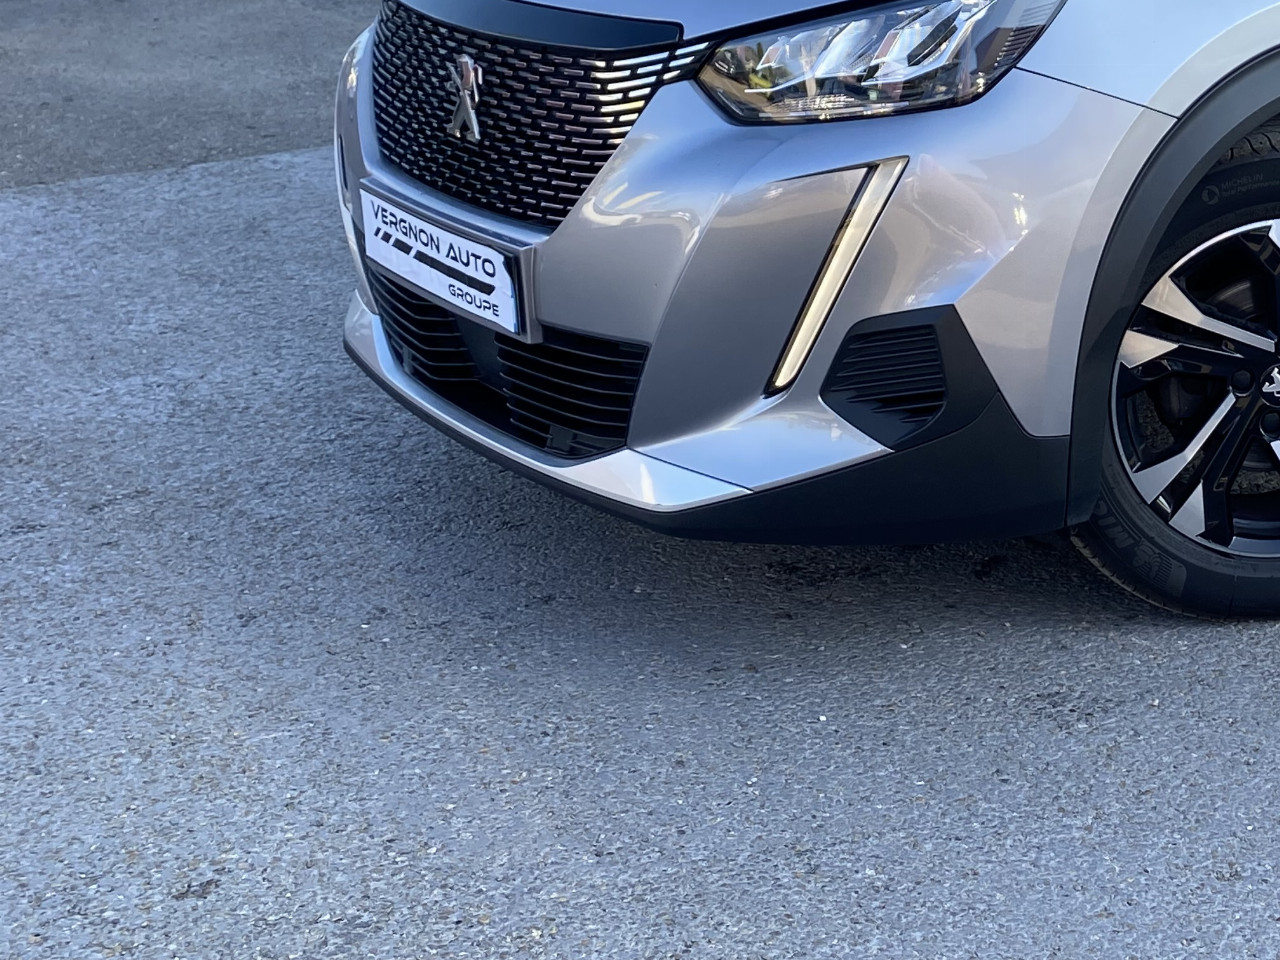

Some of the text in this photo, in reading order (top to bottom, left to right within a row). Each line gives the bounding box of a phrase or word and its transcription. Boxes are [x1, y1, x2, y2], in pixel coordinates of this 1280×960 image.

[371, 200, 496, 278] VERGNON AUTO
[449, 284, 500, 317] GROUPE
